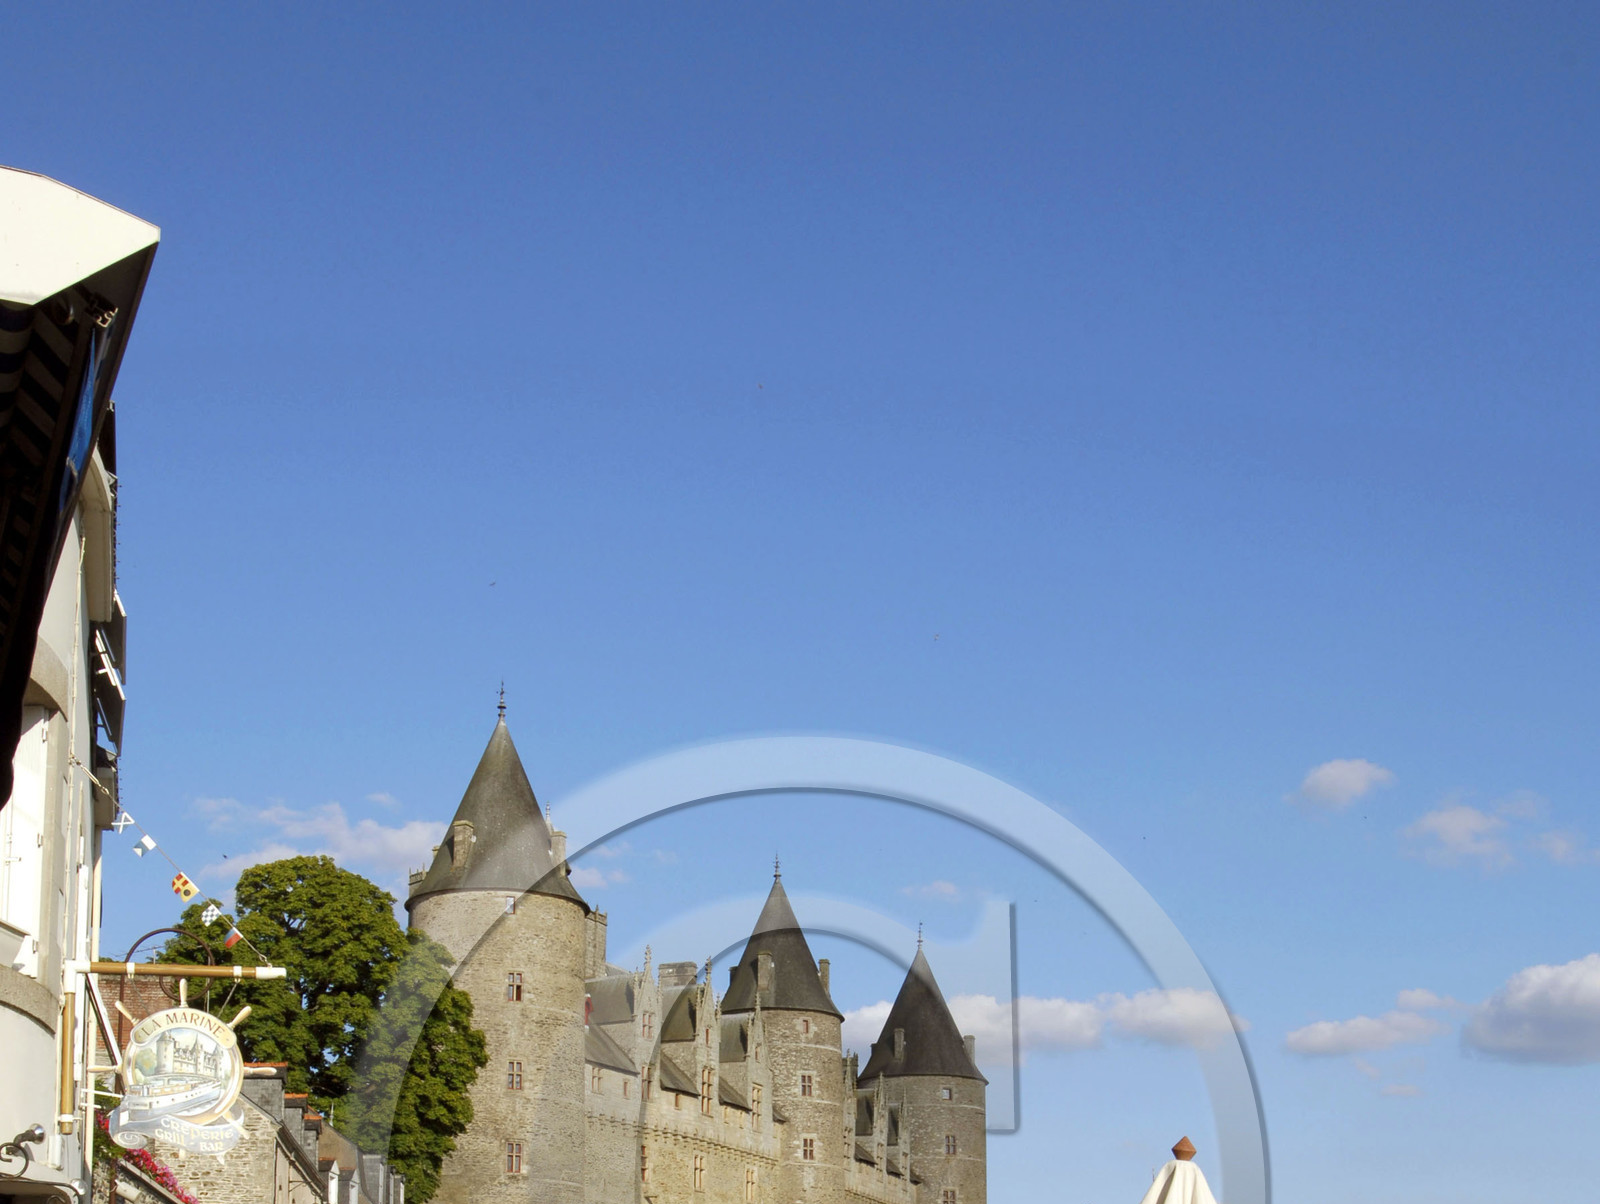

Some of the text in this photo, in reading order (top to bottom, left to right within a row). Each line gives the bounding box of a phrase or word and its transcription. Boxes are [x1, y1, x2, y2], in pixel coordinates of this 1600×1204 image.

[141, 1012, 226, 1039] LA MARINE
[154, 1128, 186, 1146] GRILL
[200, 1141, 225, 1151] BAR
